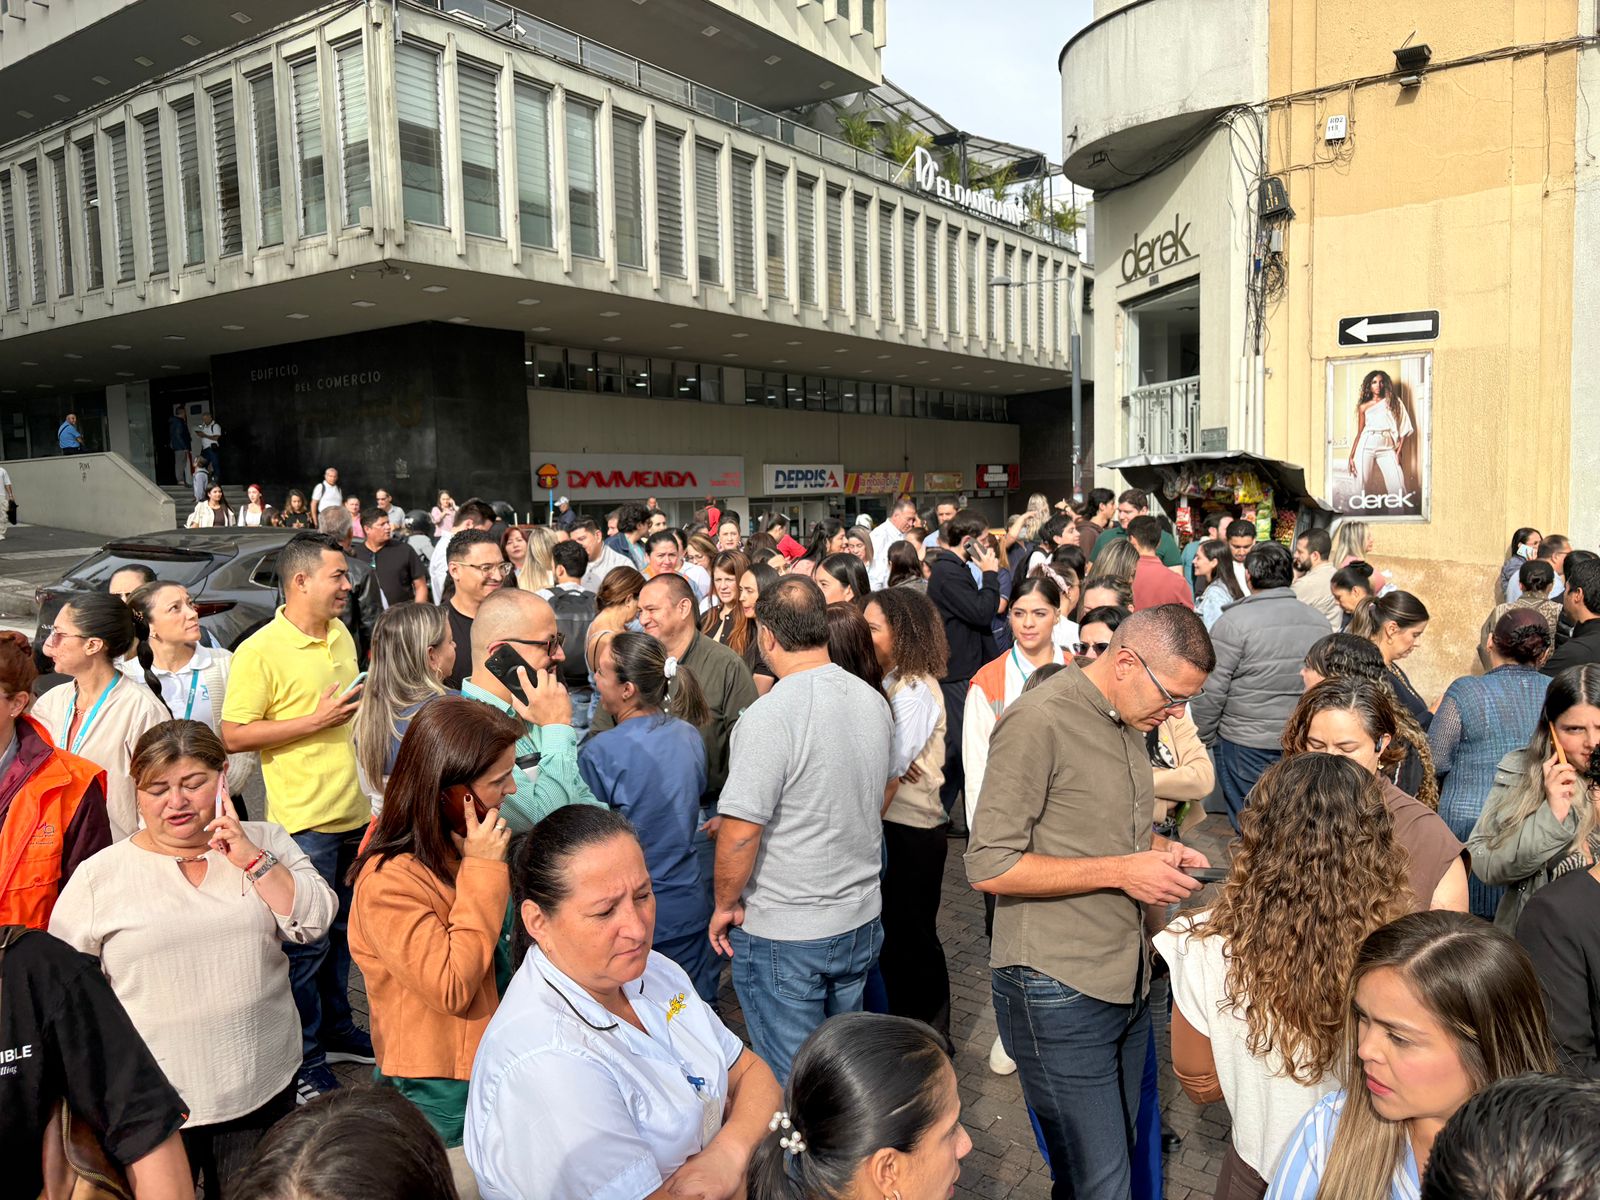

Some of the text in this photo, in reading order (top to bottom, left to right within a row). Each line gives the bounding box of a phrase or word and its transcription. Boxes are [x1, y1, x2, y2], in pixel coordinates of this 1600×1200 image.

[1122, 213, 1191, 283] derek
[295, 370, 381, 392] DEL COMERCIO
[566, 470, 697, 488] DAVIVIENDA
[775, 469, 839, 489] DEPRISA
[1349, 488, 1414, 510] derek
